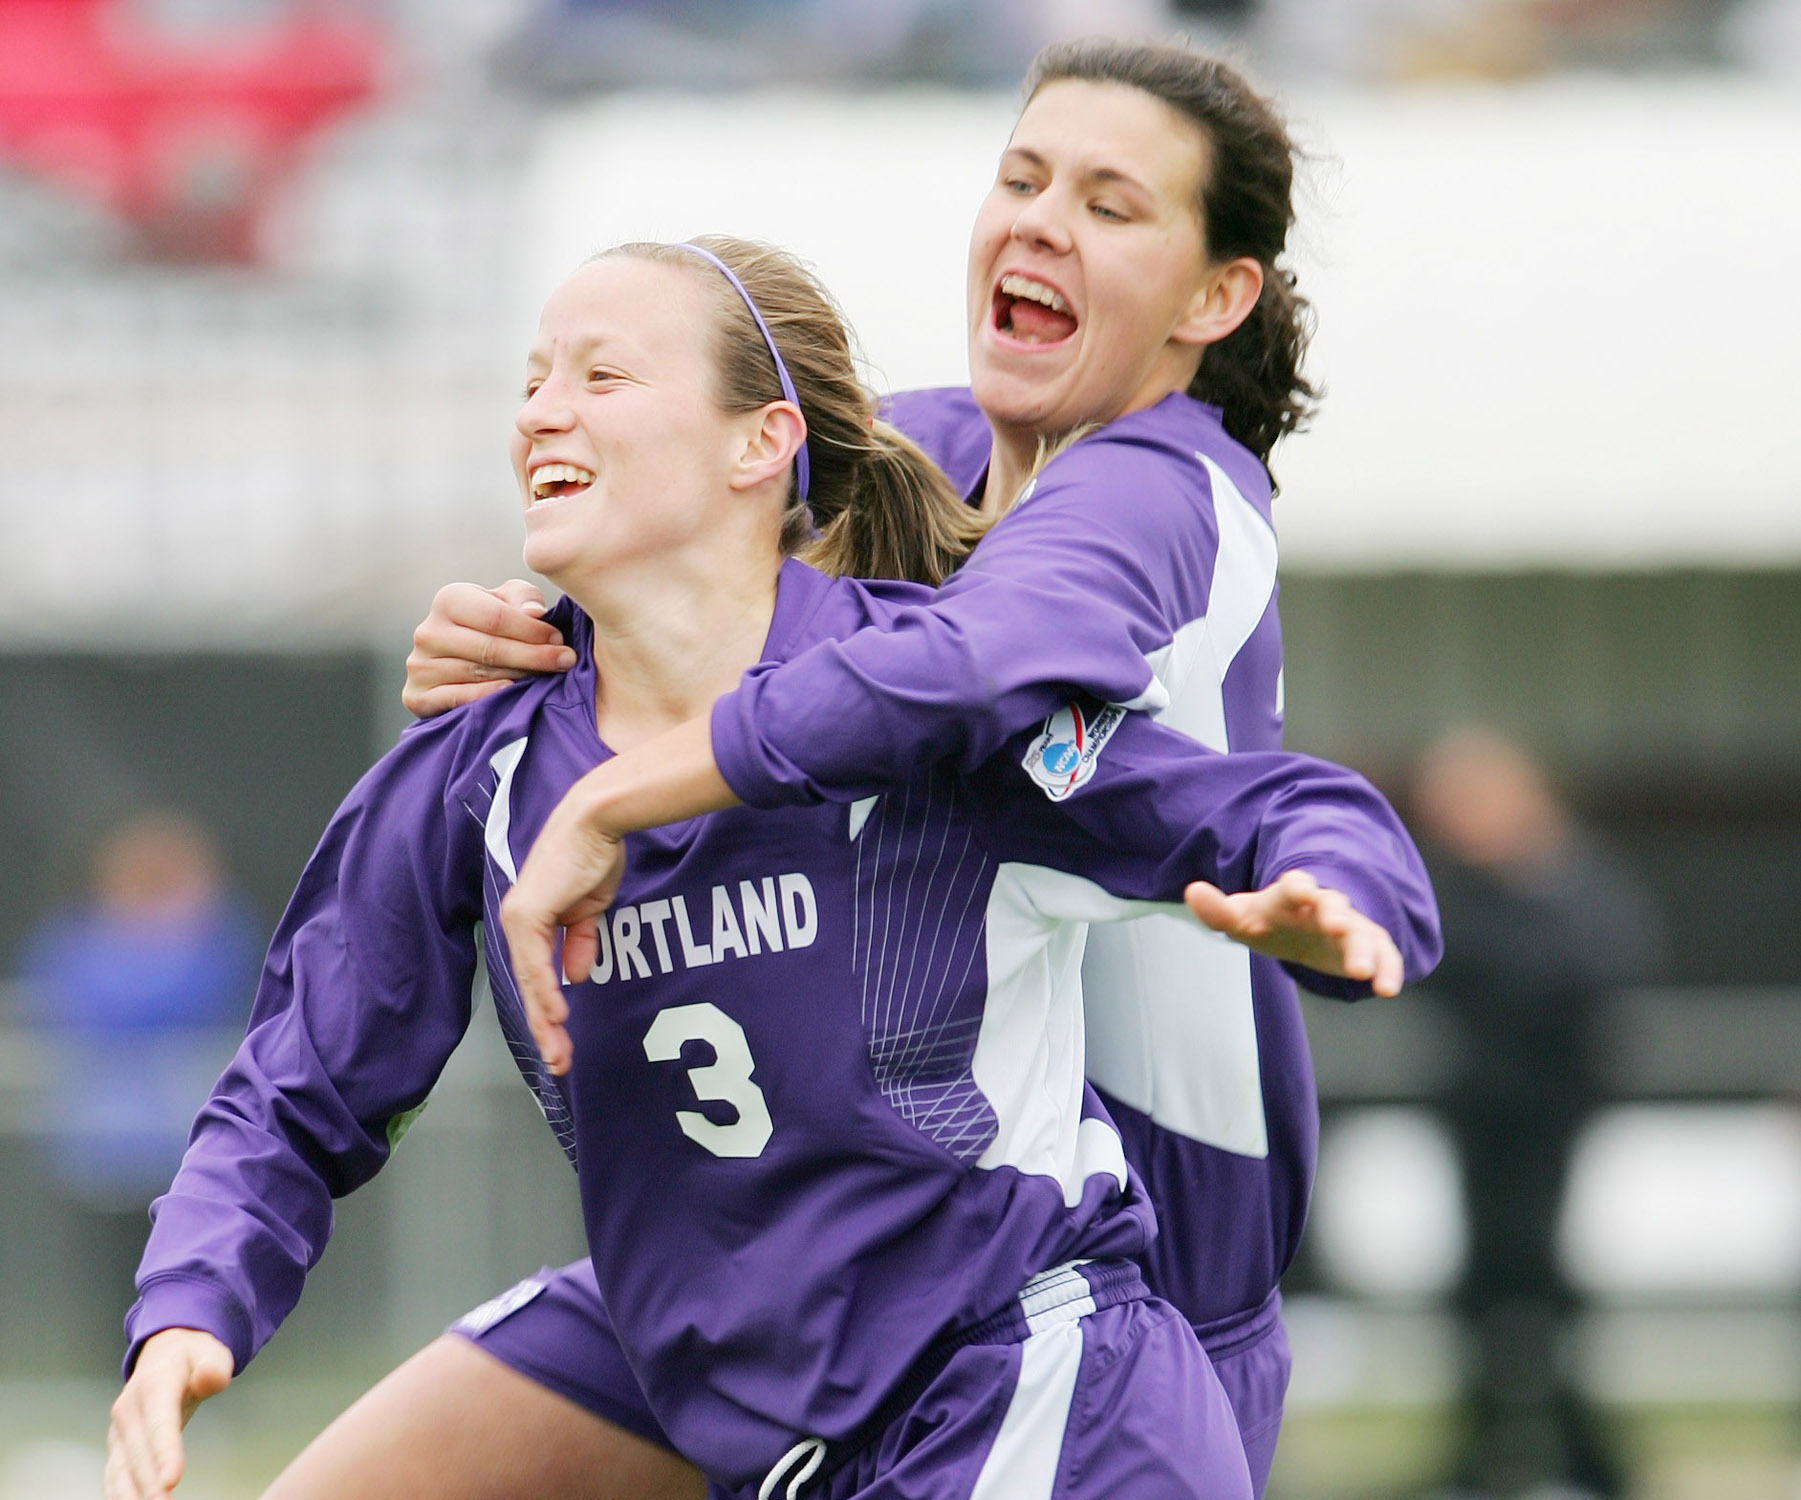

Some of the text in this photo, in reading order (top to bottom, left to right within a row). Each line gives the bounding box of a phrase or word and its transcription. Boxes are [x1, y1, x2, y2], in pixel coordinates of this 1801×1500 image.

[1053, 744, 1077, 772] NCAA
[561, 872, 819, 986] ORTLAND
[642, 1002, 774, 1158] 3
